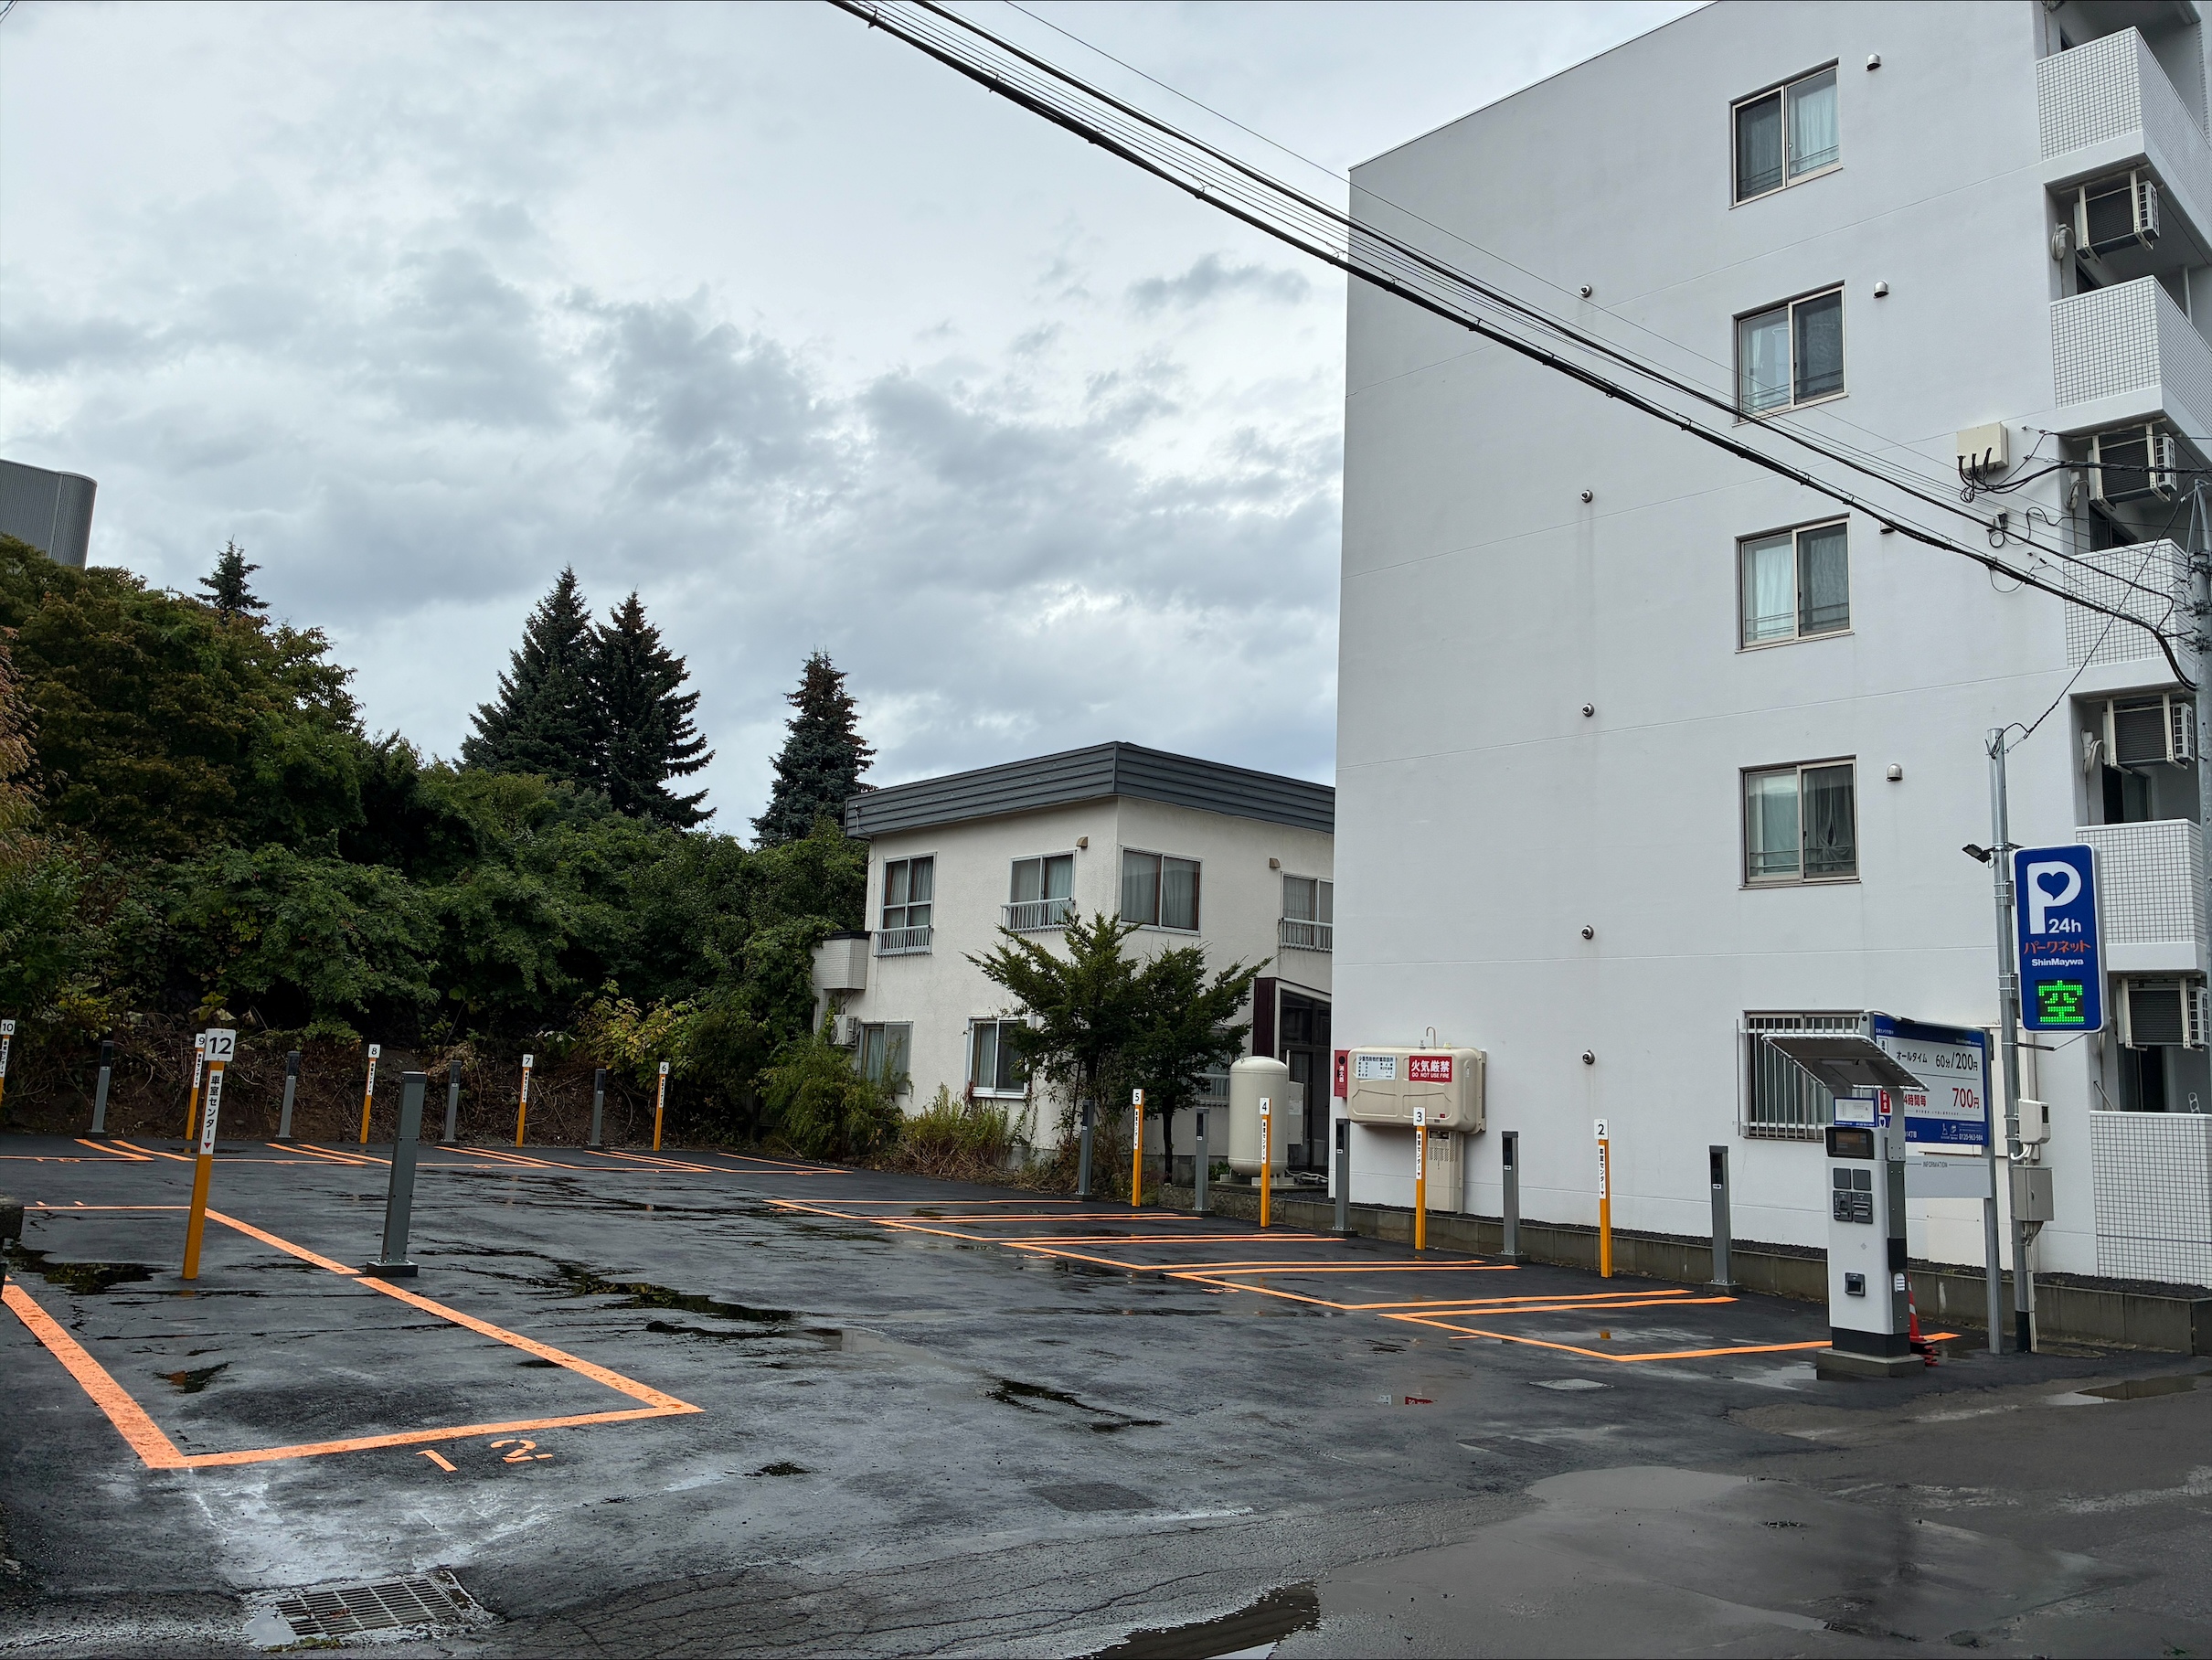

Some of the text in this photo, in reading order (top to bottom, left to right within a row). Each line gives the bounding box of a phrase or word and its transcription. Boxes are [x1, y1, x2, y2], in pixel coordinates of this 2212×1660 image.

[2026, 861, 2081, 934] P
[2048, 918, 2081, 933] 24h
[2024, 940, 2091, 954] パークネット
[2031, 958, 2084, 967] ShinMaywa
[2038, 980, 2084, 1023] 空
[3, 1023, 13, 1031] 10
[198, 1037, 205, 1045] 9
[209, 1037, 231, 1055] 12
[371, 1047, 378, 1055] 8
[1896, 1050, 1928, 1063] オールタイム
[525, 1057, 531, 1065] 7
[1411, 1059, 1451, 1073] 火気厳禁
[1134, 1092, 1140, 1101] 5
[1951, 1087, 1980, 1109] 700円
[206, 1075, 221, 1139] 車室センター
[1261, 1101, 1268, 1112] 4
[1416, 1112, 1422, 1123] 3
[1597, 1123, 1605, 1135] 2
